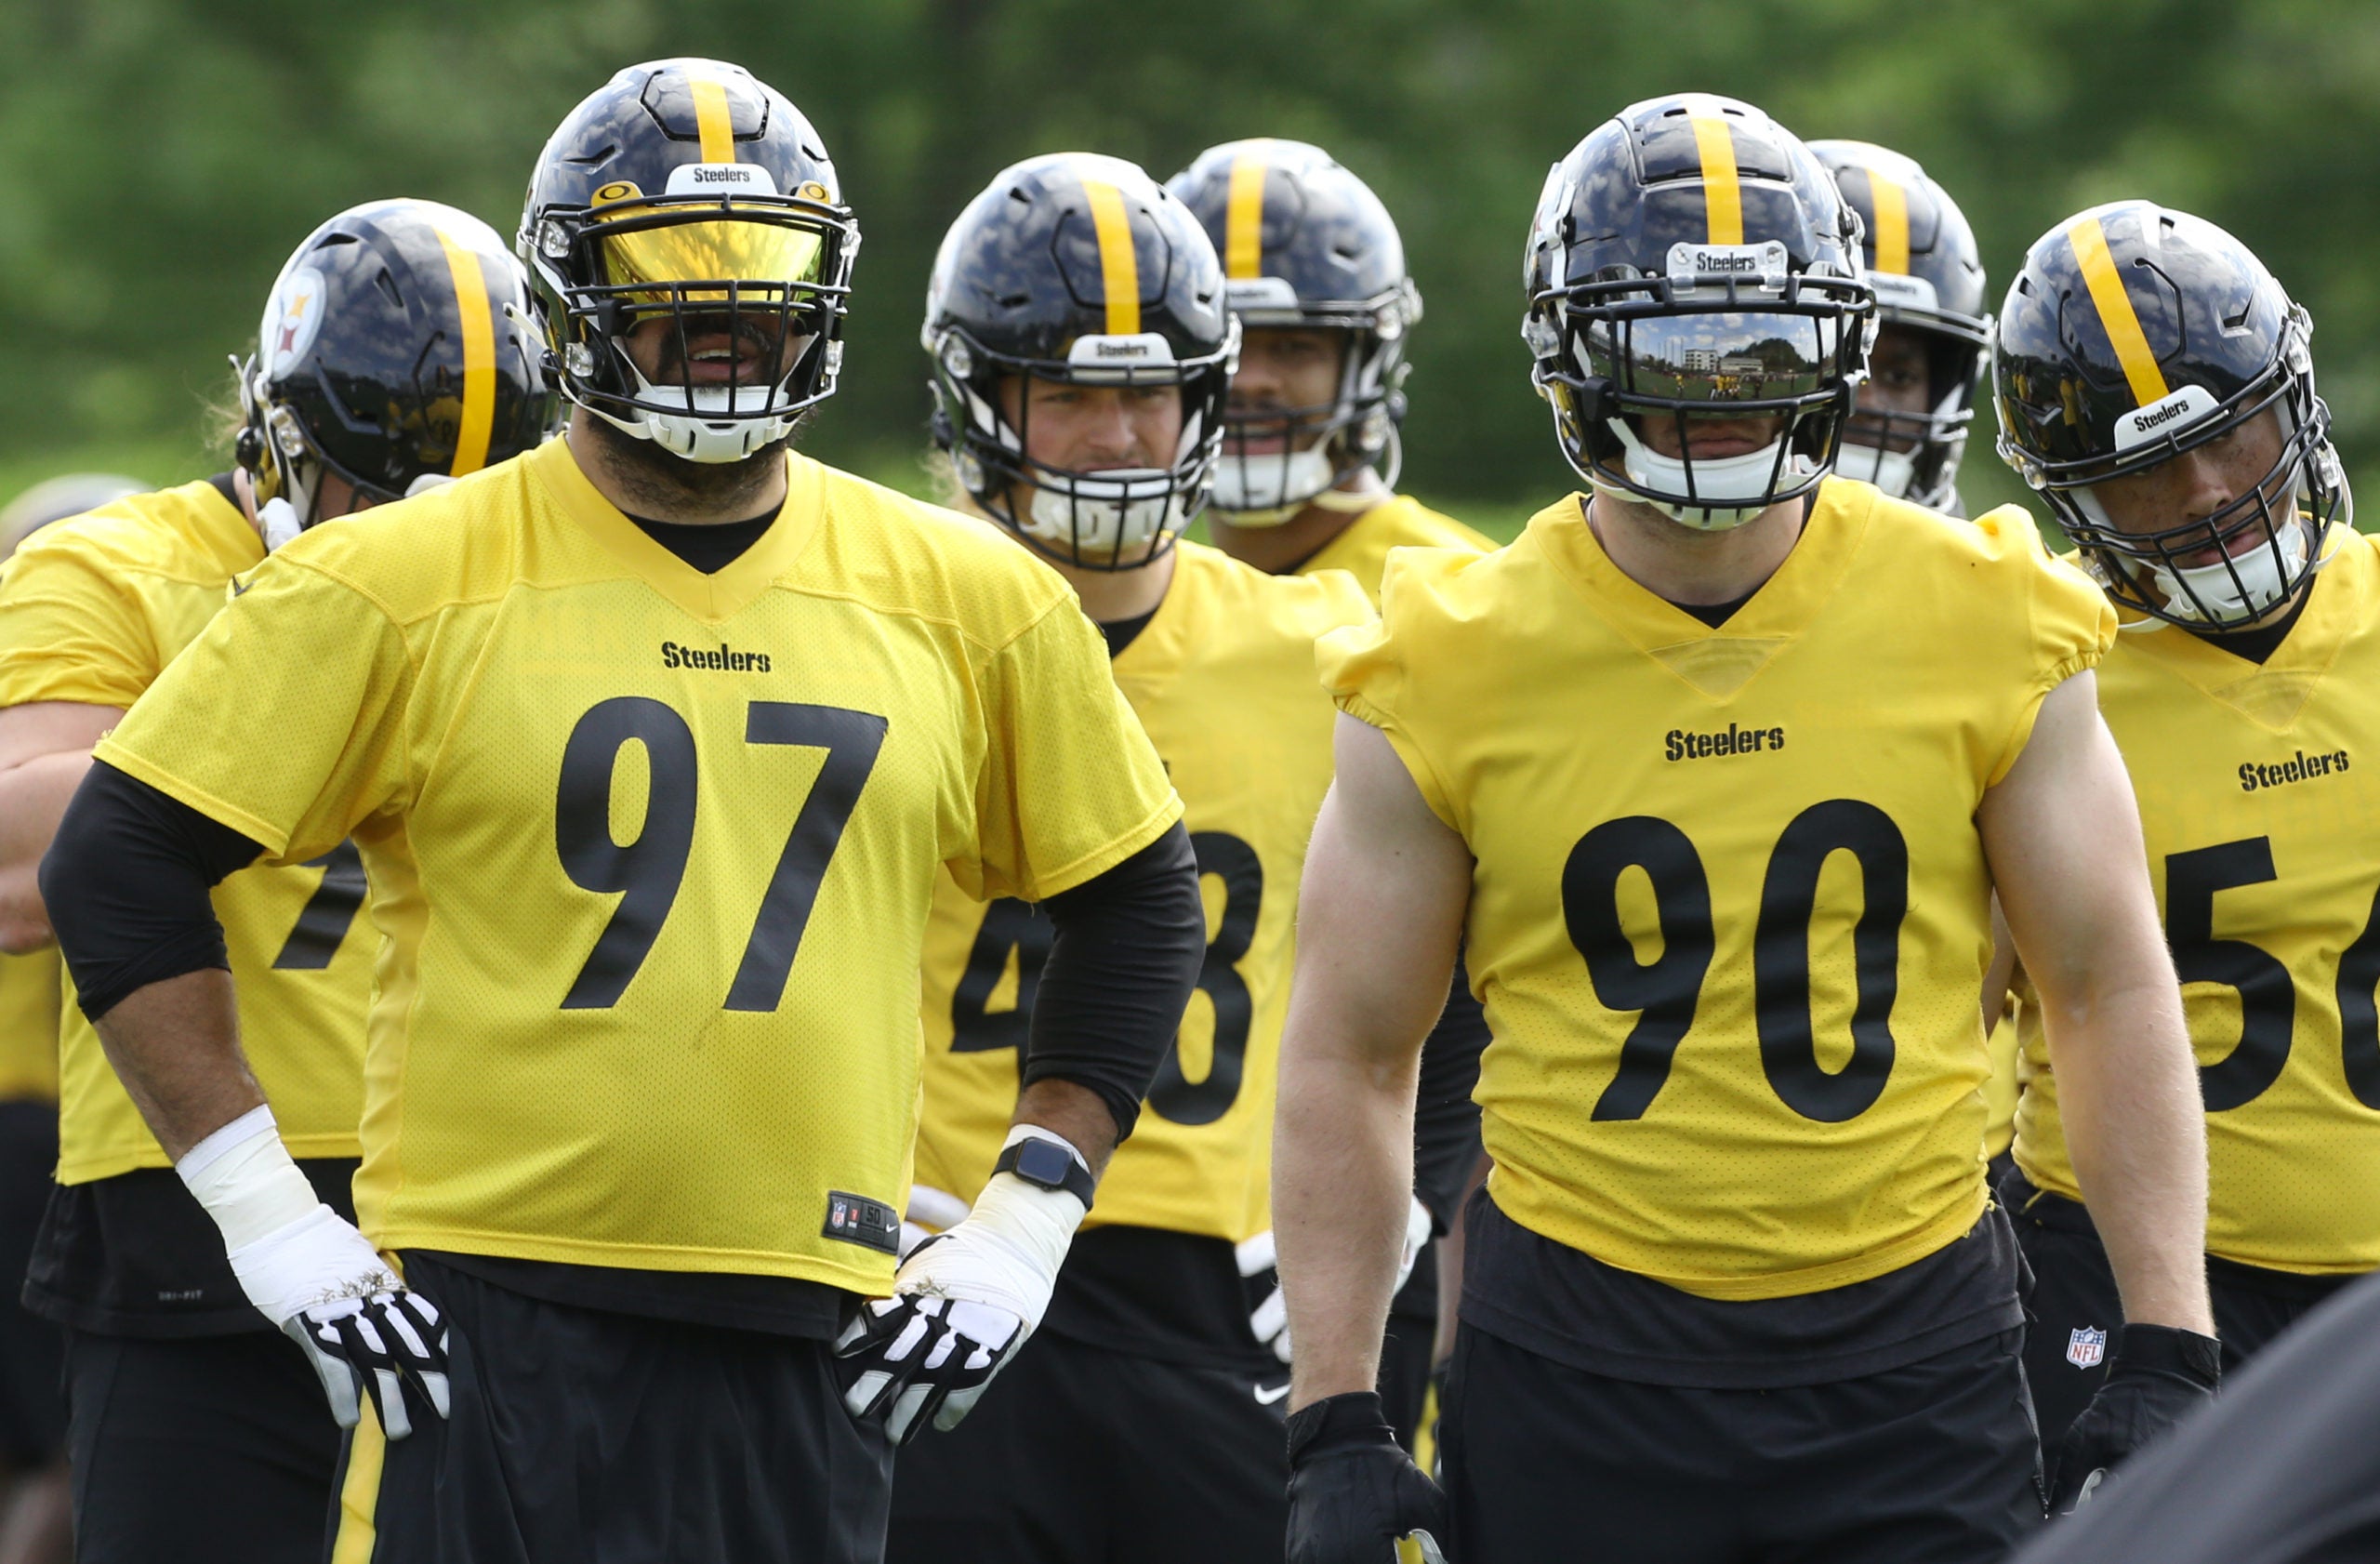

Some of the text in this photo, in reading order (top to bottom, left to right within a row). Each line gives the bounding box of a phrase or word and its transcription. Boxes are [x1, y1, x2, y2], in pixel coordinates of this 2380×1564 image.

[694, 167, 750, 183] Steelers
[1696, 251, 1755, 272] Steelers
[2134, 400, 2189, 432] Steelers
[661, 641, 771, 673] Steelers
[1665, 722, 1785, 762] Steelers
[2238, 749, 2350, 792] Steelers
[555, 696, 890, 1013] 97
[949, 830, 1263, 1126] 48
[1561, 798, 1909, 1123] 90
[2072, 1344, 2099, 1362] NFL
